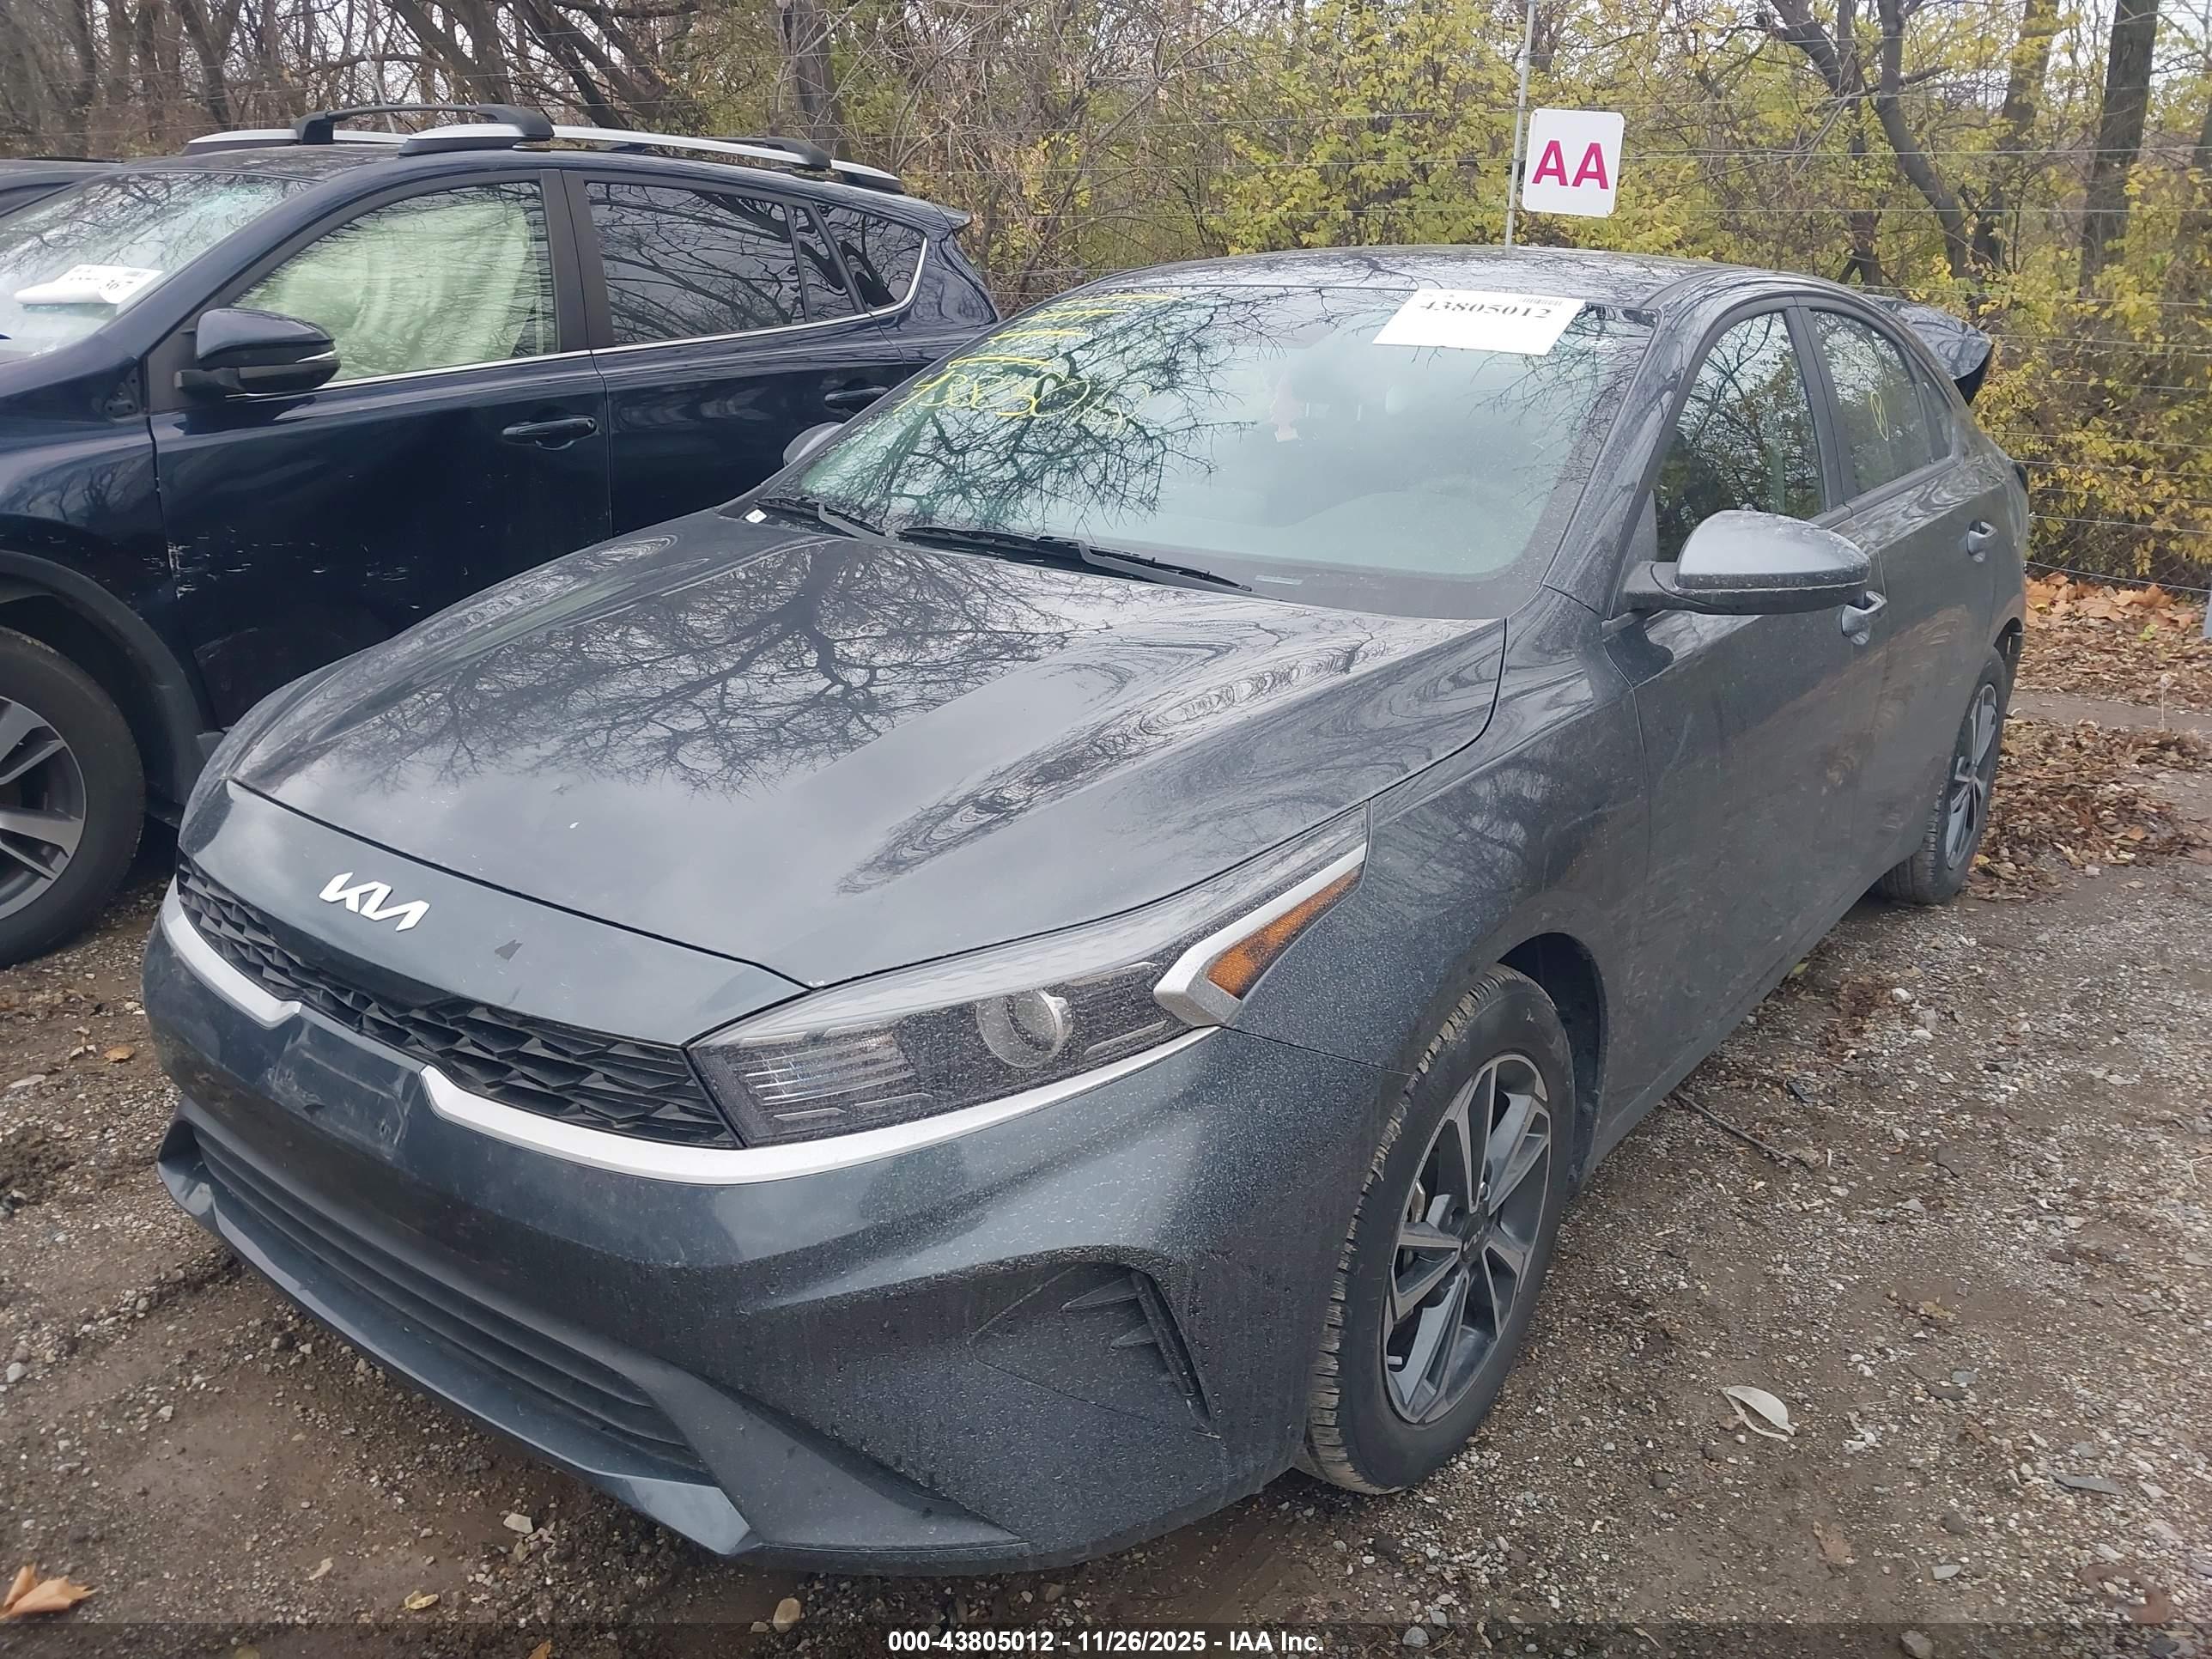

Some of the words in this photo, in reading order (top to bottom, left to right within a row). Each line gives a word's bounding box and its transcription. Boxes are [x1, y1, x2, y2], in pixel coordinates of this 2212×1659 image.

[1532, 140, 1609, 190] AA
[1419, 301, 1553, 319] 43805012
[319, 872, 430, 932] KIA
